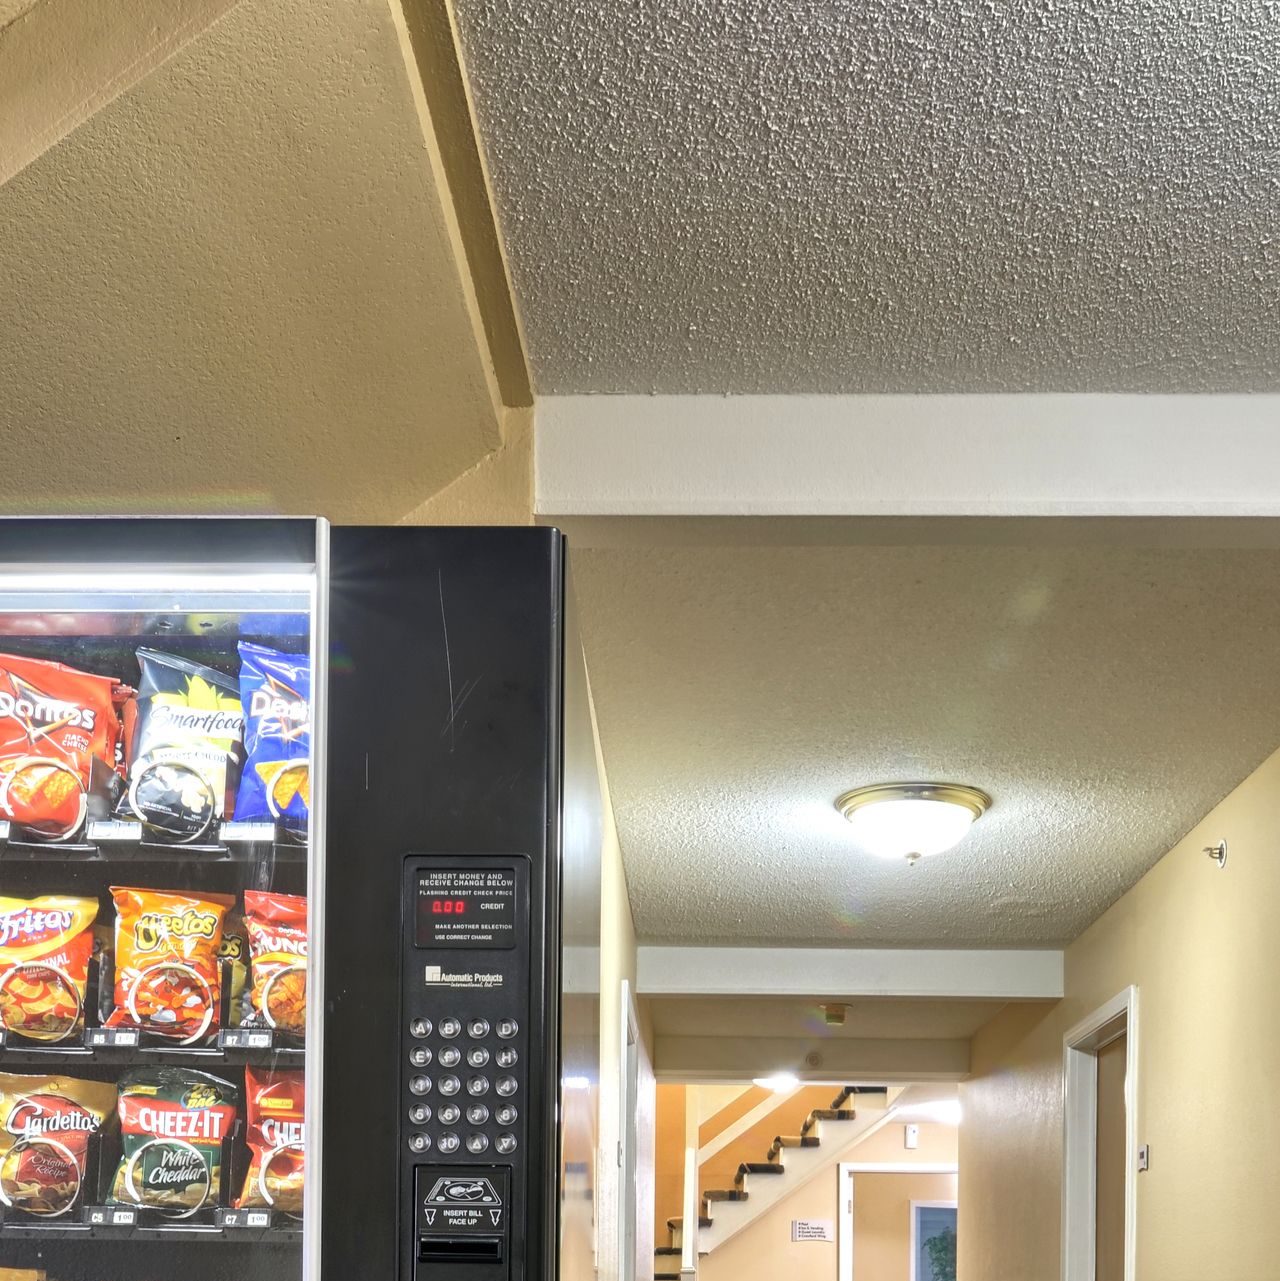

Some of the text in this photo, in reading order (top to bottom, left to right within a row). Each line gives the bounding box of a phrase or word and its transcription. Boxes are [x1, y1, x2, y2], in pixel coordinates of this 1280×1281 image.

[135, 911, 217, 951] Ceetos
[441, 973, 503, 983] Automatic Products
[416, 1023, 511, 1034] A B C D
[94, 1035, 105, 1043] B5
[227, 1036, 238, 1045] B7
[416, 1051, 511, 1063] E F G H
[417, 1081, 510, 1092] 1 2 3 4
[187, 1094, 217, 1109] BAG
[7, 1102, 103, 1138] Gardetto's
[416, 1109, 510, 1120] 5 6 7 8
[139, 1107, 224, 1139] CHEEZ-IT
[416, 1137, 455, 1149] 9 10
[162, 1150, 200, 1167] White
[33, 1164, 67, 1178] Recipe
[148, 1166, 206, 1184] Cheddar
[92, 1214, 103, 1222] C5
[226, 1215, 237, 1224] C7
[449, 1218, 477, 1226] FACE UP
